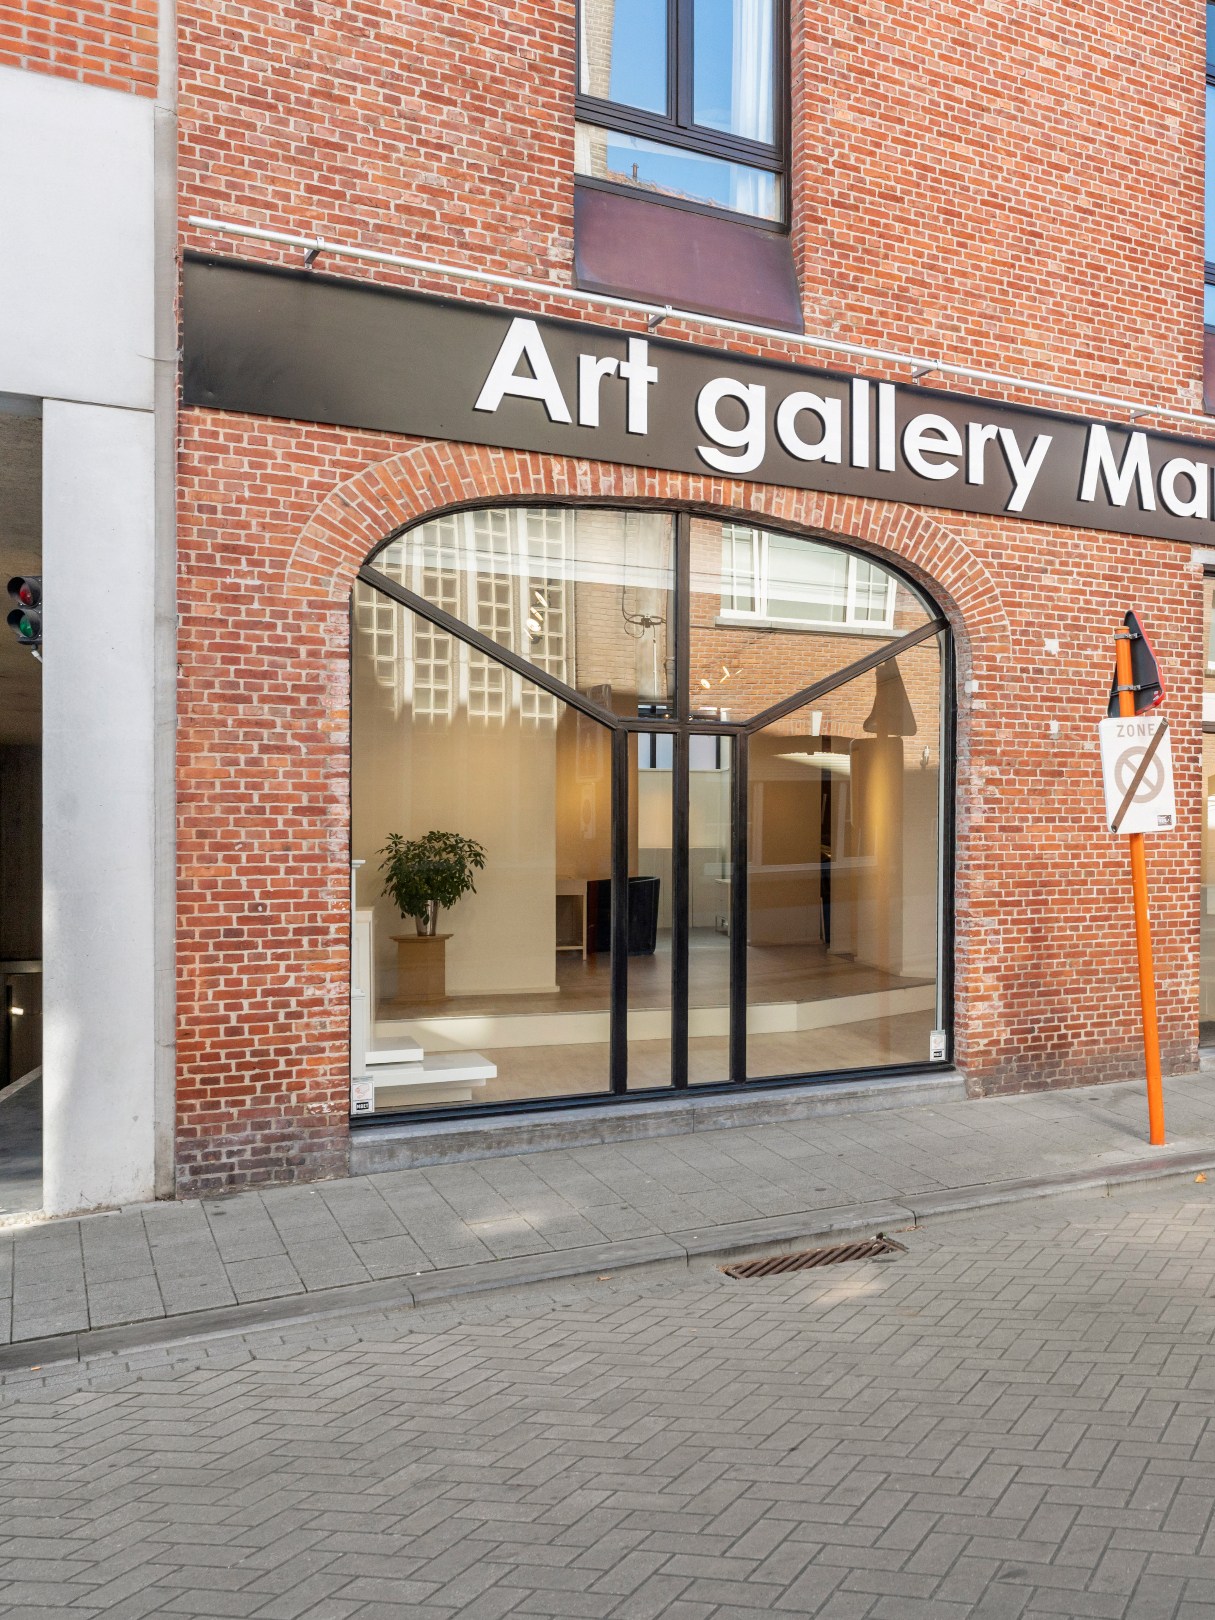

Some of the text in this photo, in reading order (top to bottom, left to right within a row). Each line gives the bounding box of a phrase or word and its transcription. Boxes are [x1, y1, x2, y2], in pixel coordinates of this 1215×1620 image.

[474, 317, 658, 435] Art
[696, 376, 1053, 512] gallery
[1116, 723, 1156, 738] ZONE
